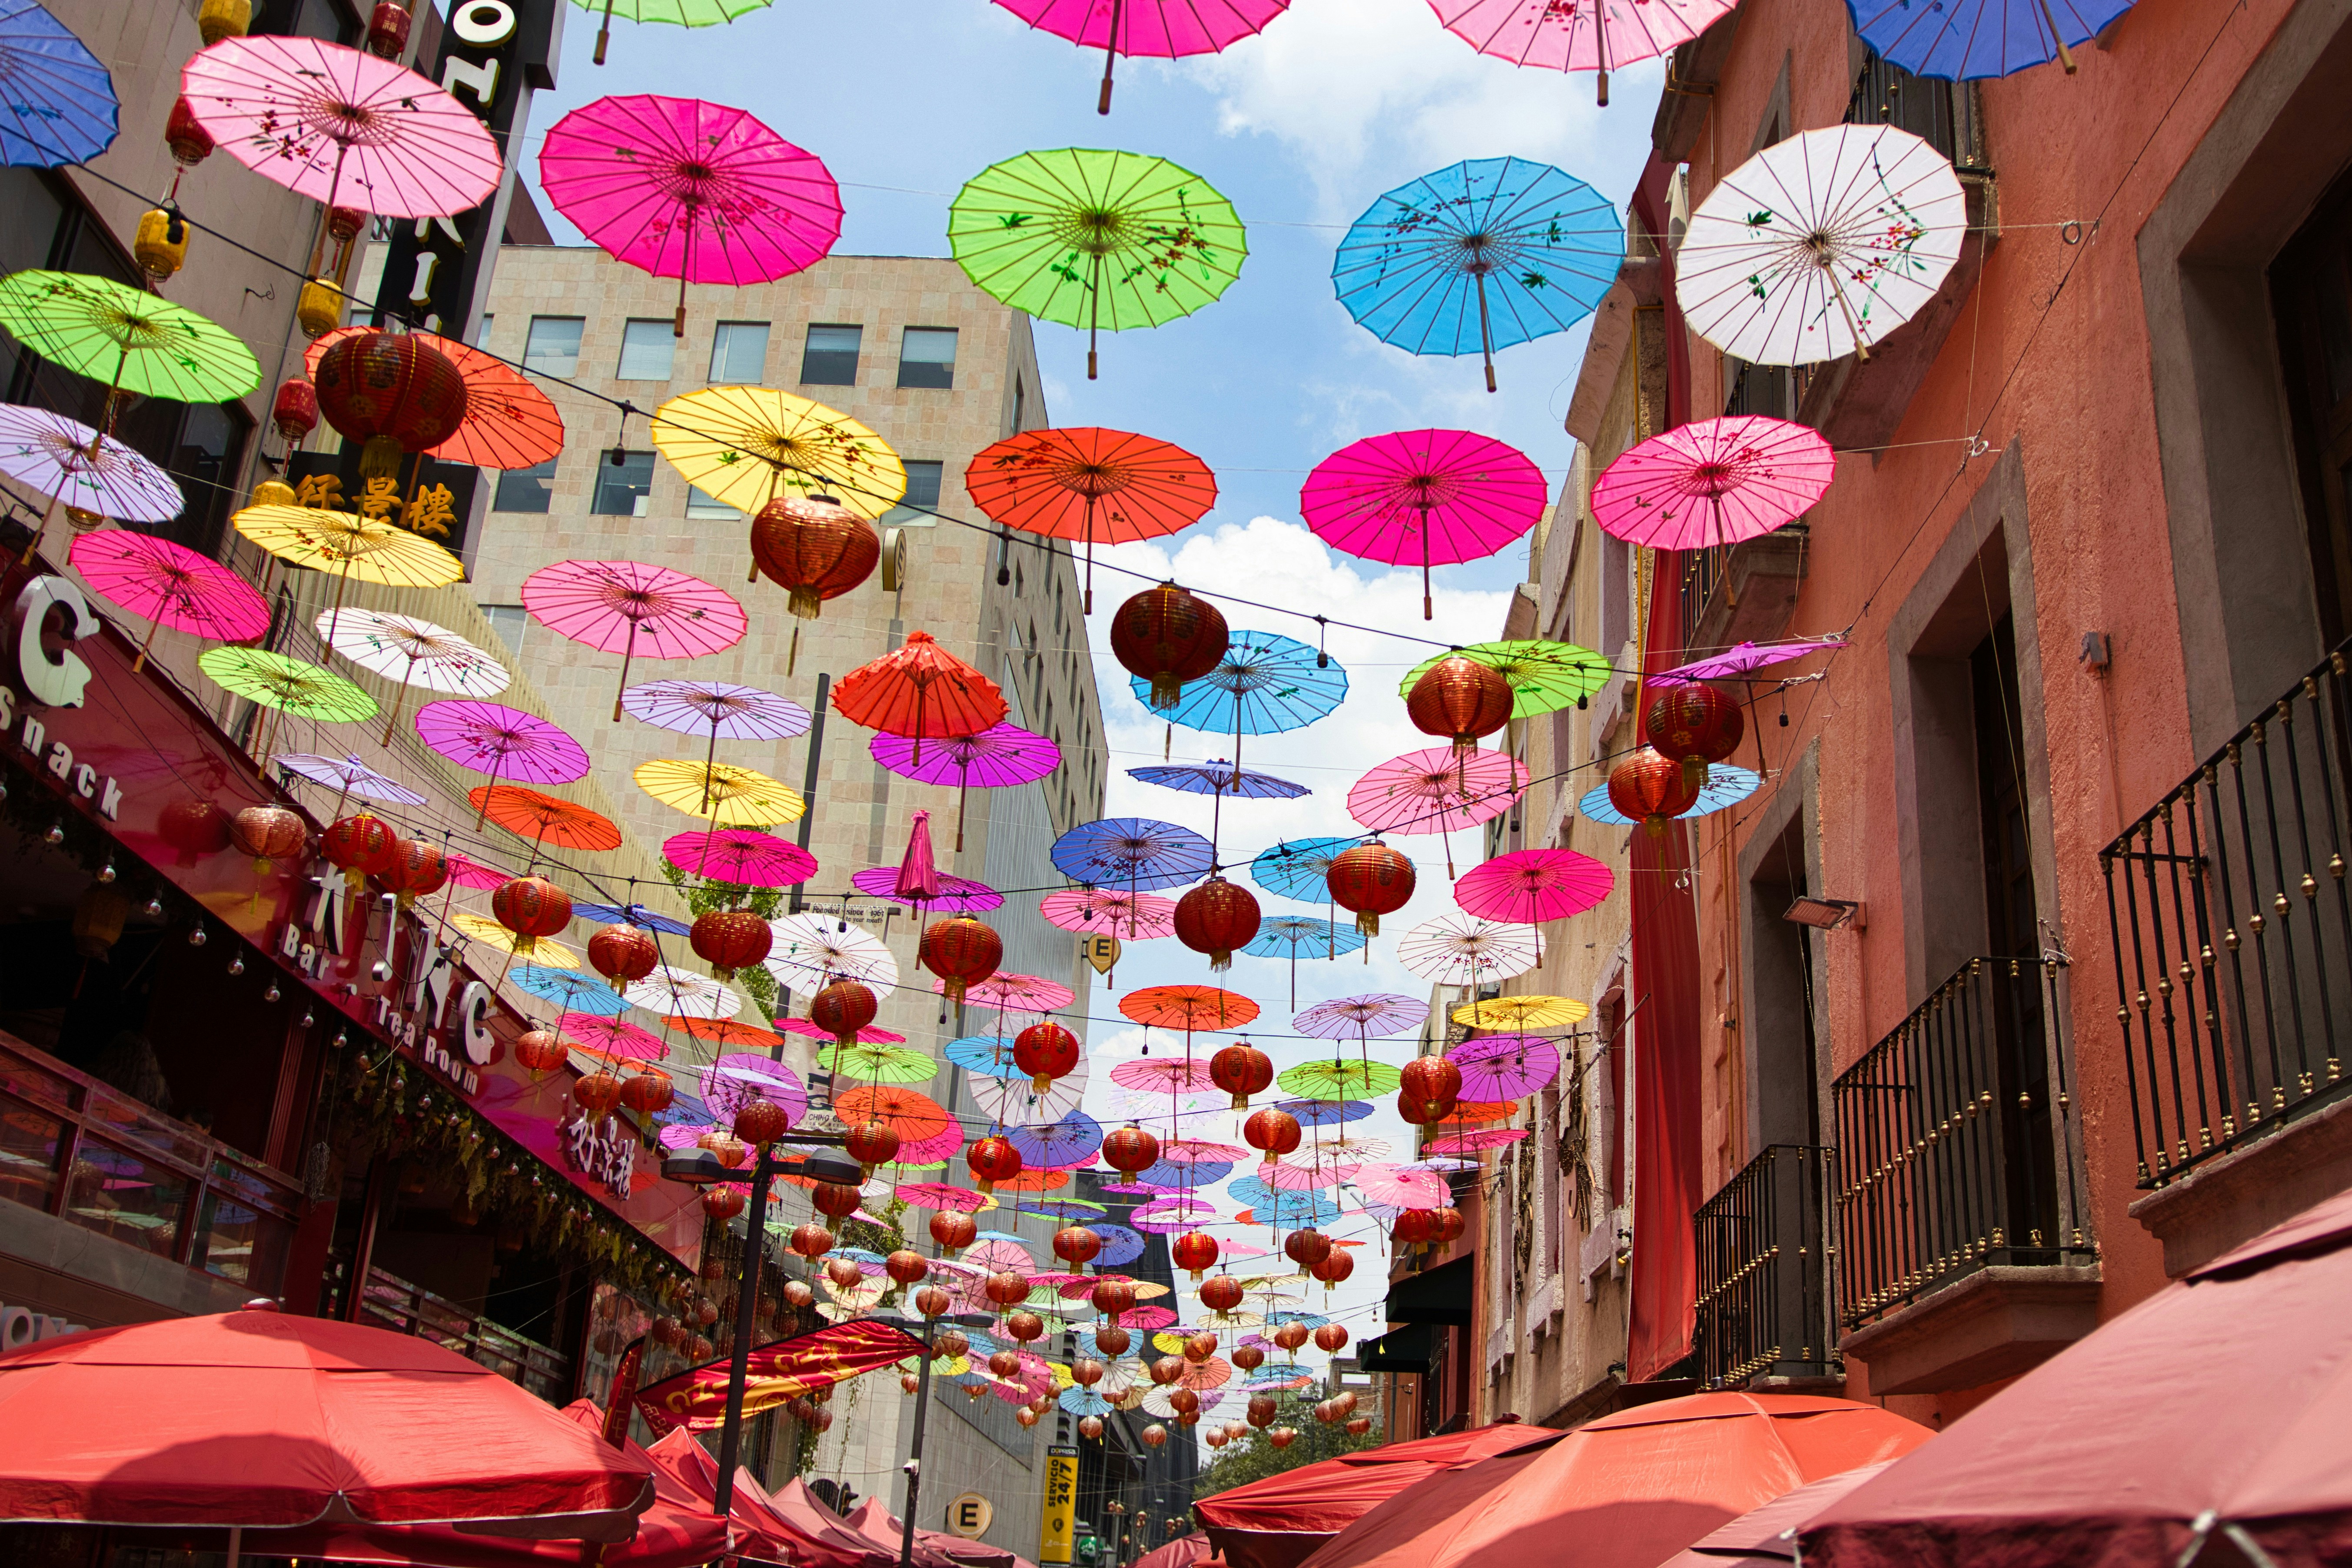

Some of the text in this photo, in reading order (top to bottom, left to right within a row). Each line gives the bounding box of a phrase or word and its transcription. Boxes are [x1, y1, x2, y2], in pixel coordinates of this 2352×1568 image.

[382, 20, 398, 33] 福
[897, 540, 905, 574] E
[0, 685, 478, 1096] Snack Bar Tea Room
[812, 906, 840, 914] Founded
[1096, 939, 1110, 957] E
[1048, 1459, 1059, 1507] SERVICIO
[1057, 1462, 1072, 1505] 24/7
[960, 1503, 978, 1527] E
